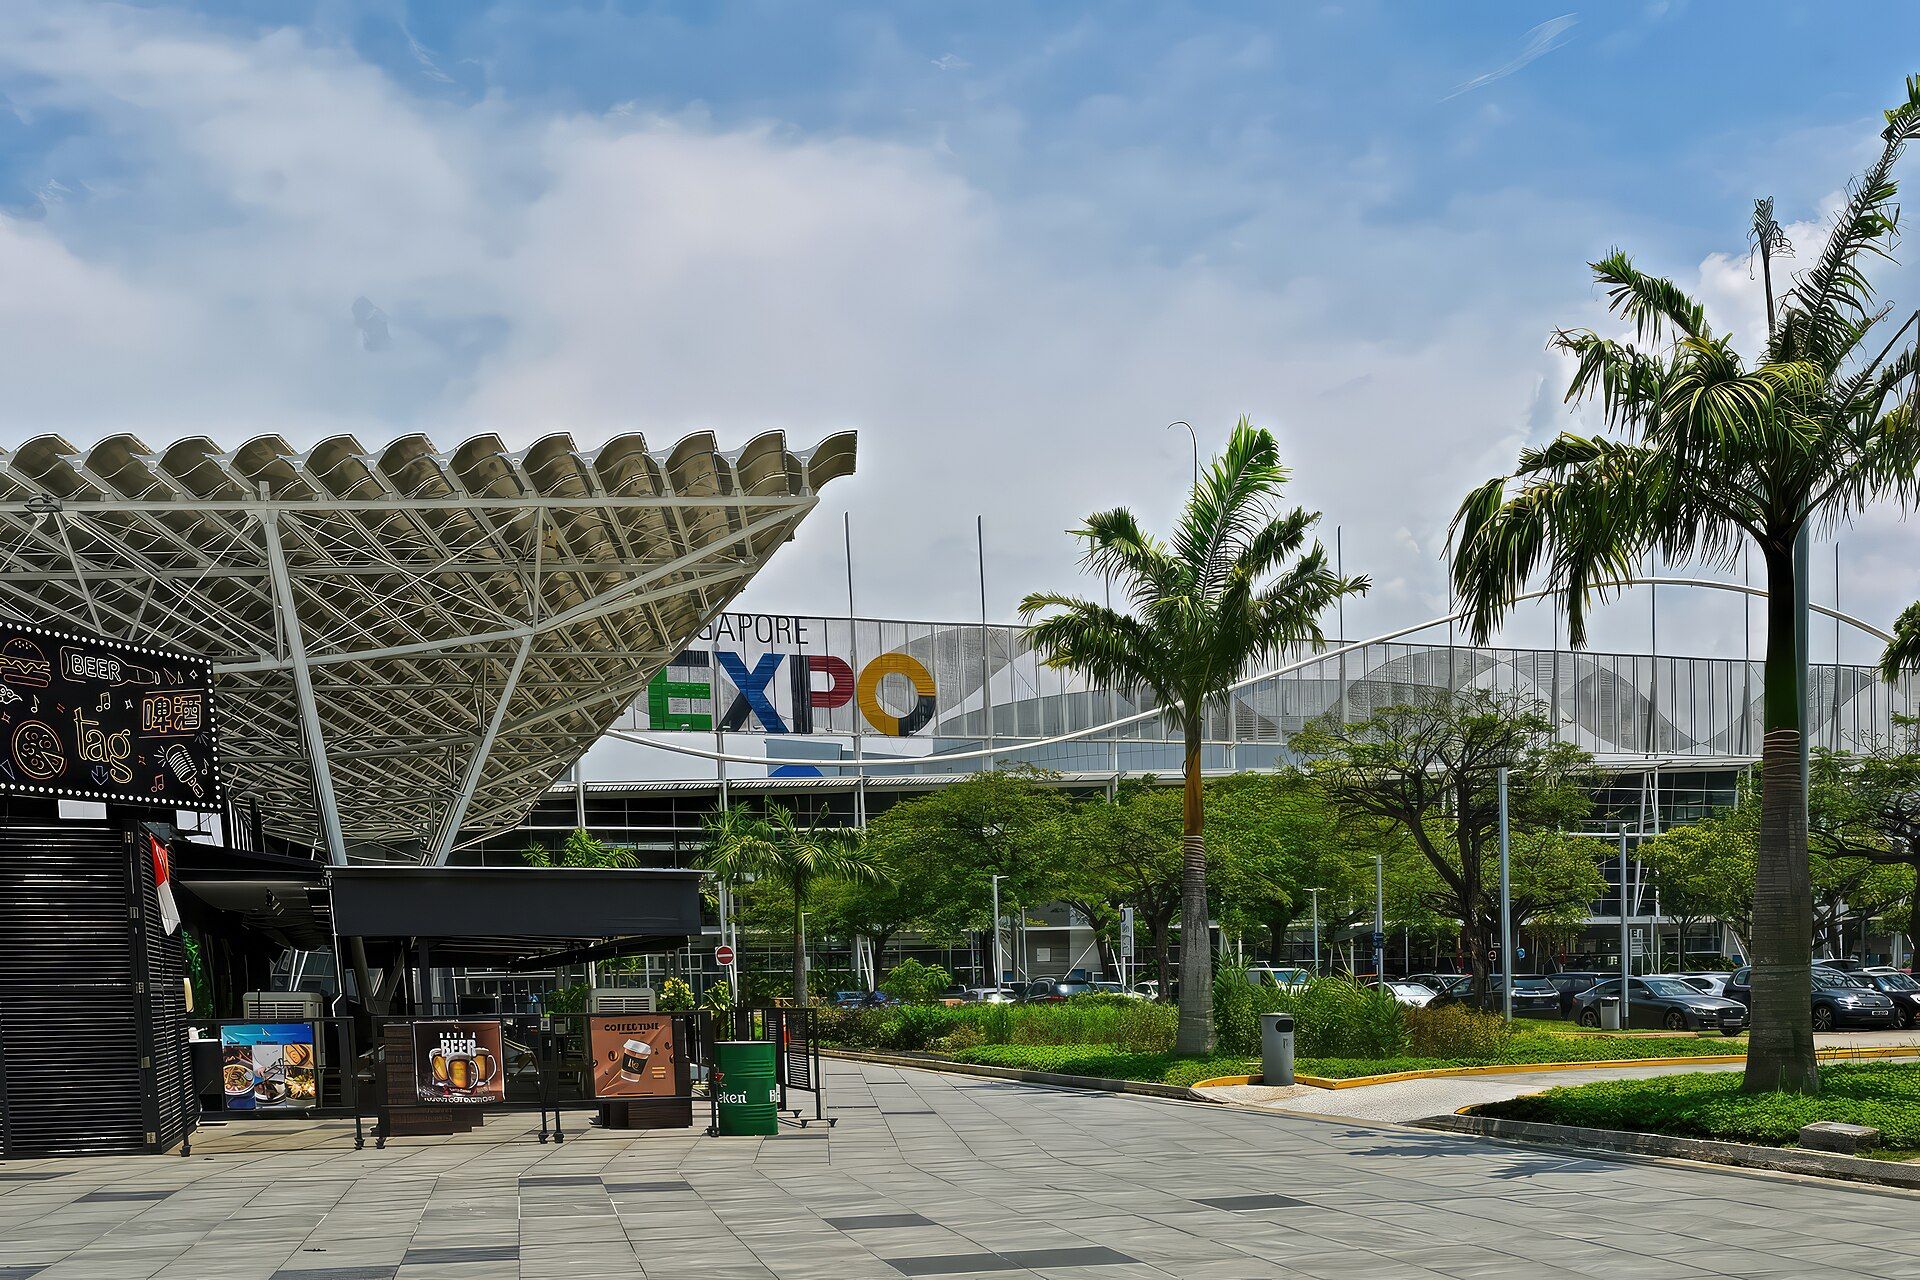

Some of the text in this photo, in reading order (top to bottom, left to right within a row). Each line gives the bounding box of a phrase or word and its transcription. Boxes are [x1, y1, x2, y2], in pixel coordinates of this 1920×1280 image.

[71, 655, 121, 681] BEER
[648, 651, 936, 736] EXPO
[142, 695, 201, 732] 啤酒
[74, 707, 132, 783] tag
[440, 1039, 477, 1057] BEER
